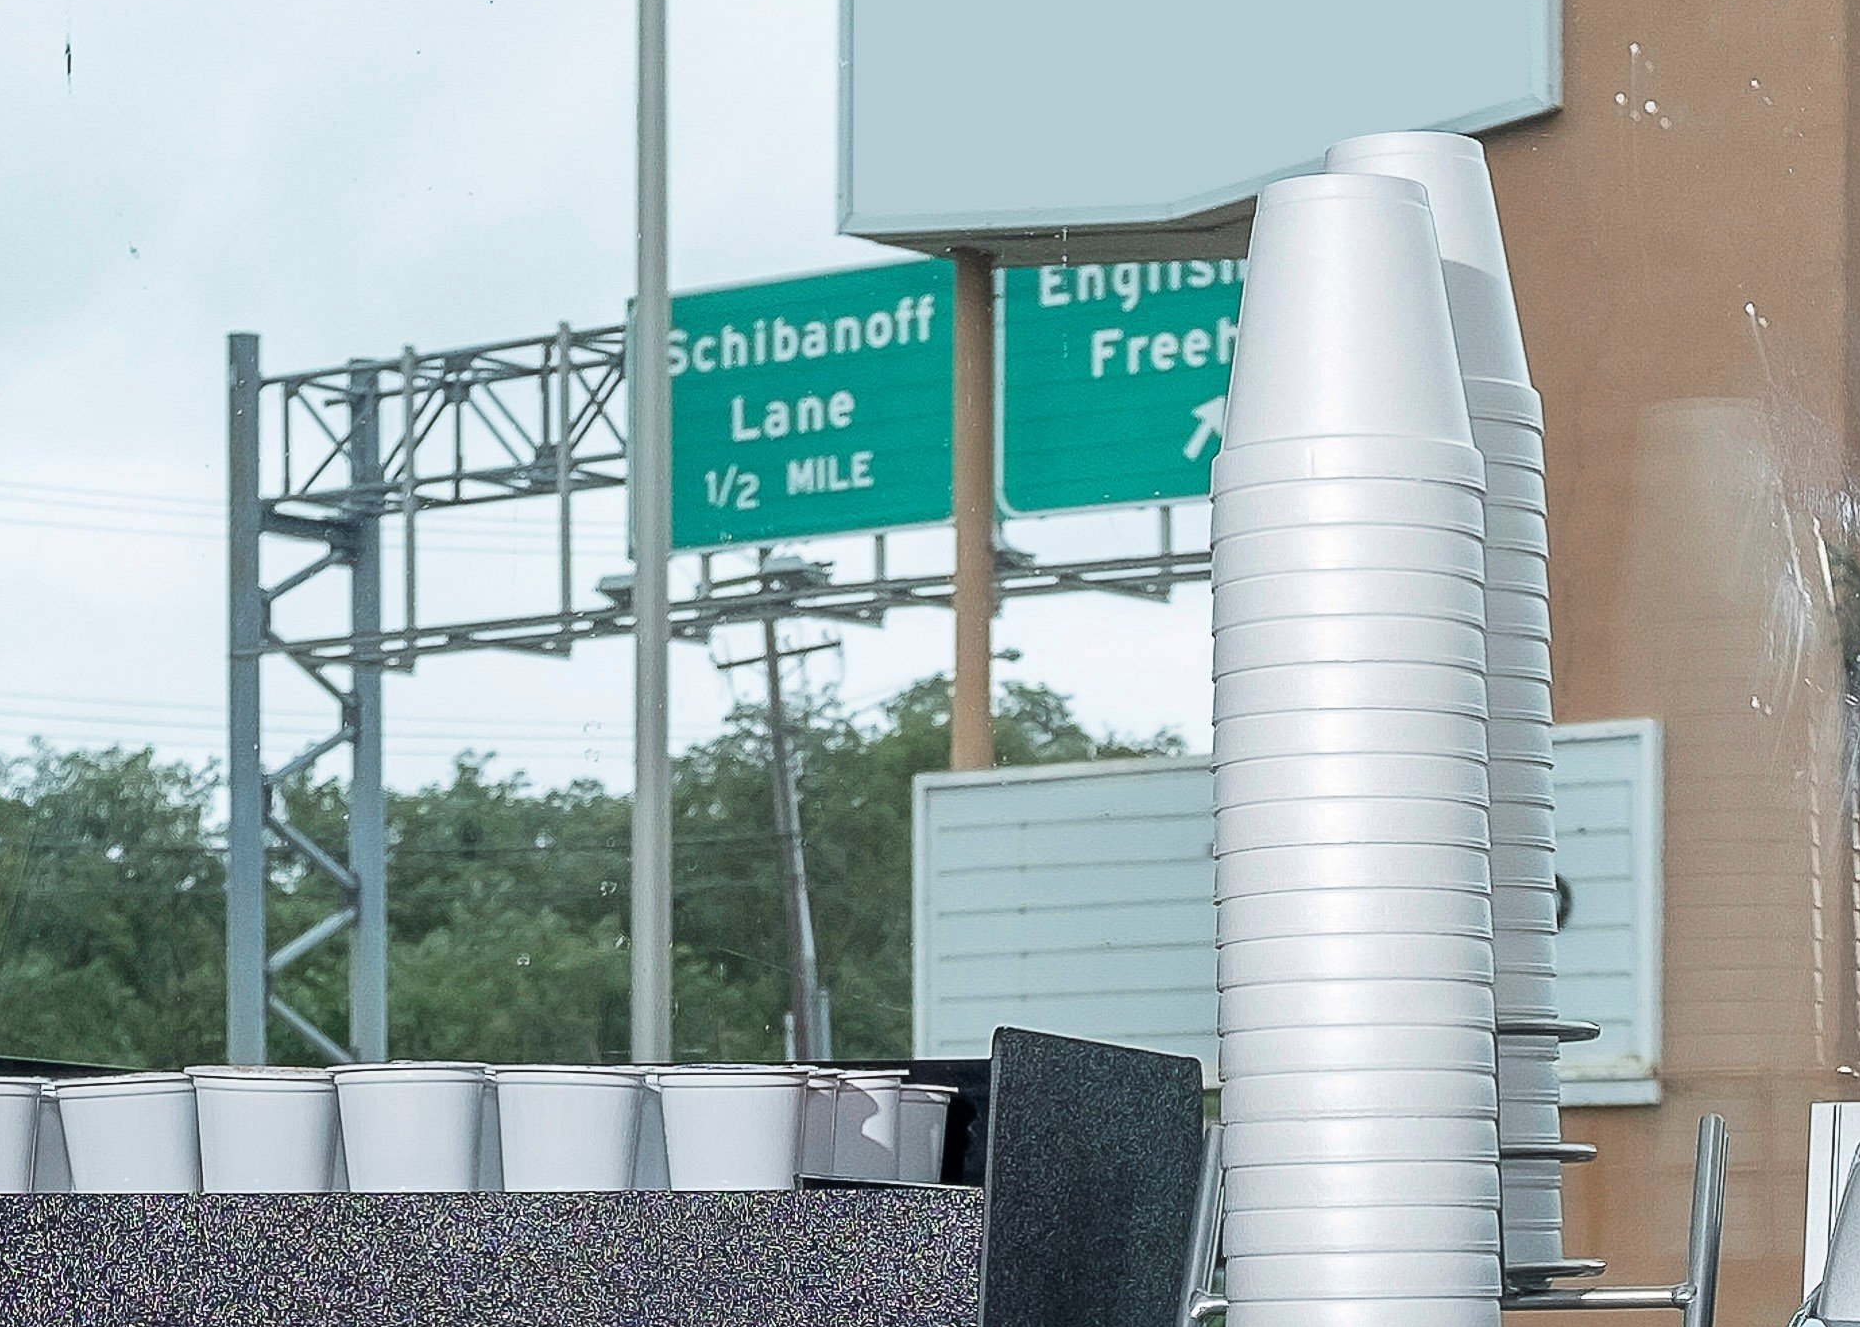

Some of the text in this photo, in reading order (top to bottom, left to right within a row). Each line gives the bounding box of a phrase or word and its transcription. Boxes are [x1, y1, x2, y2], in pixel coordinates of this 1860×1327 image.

[667, 293, 935, 376] Schibanoff
[1091, 316, 1239, 378] Freeh
[731, 390, 856, 442] Lane
[704, 450, 874, 510] 1/2 MILE
